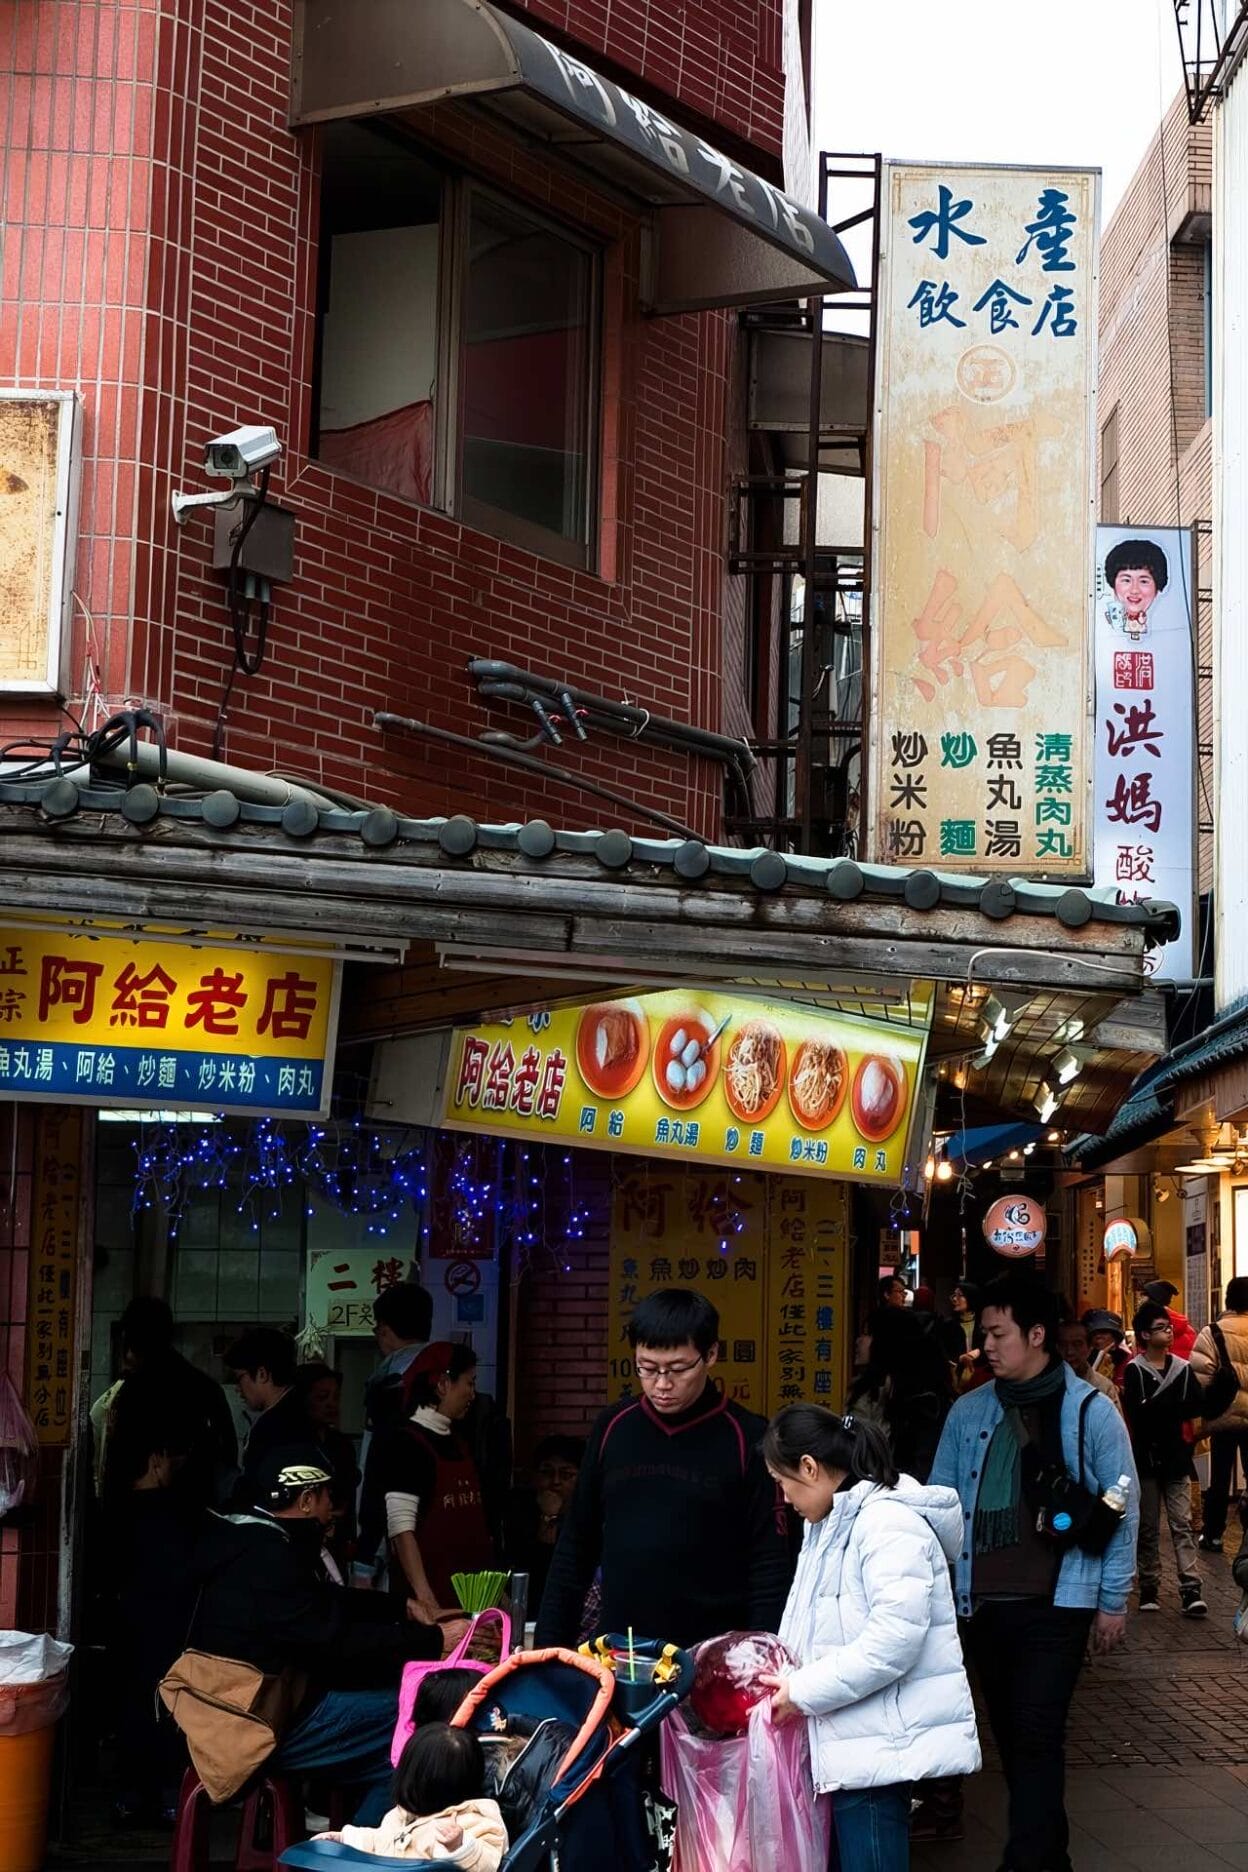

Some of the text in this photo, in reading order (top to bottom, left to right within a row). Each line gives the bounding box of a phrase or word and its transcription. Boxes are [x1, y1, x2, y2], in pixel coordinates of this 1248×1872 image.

[534, 32, 815, 254] 阿給老店
[908, 185, 1077, 271] 水產
[907, 279, 1078, 337] 飲食店
[889, 731, 928, 858] 炒米粉
[940, 731, 978, 857] 炒麵
[984, 731, 1023, 858] 魚丸湯
[1034, 732, 1074, 858] 清蒸肉丸
[38, 955, 318, 1040] 阿給老店
[455, 1036, 567, 1119] 阿給老店
[580, 1106, 887, 1172] 阿給 魚丸湯 炒麵 炒米粉 肉丸
[778, 1188, 807, 1412] 阿給老店僅此一家別無
